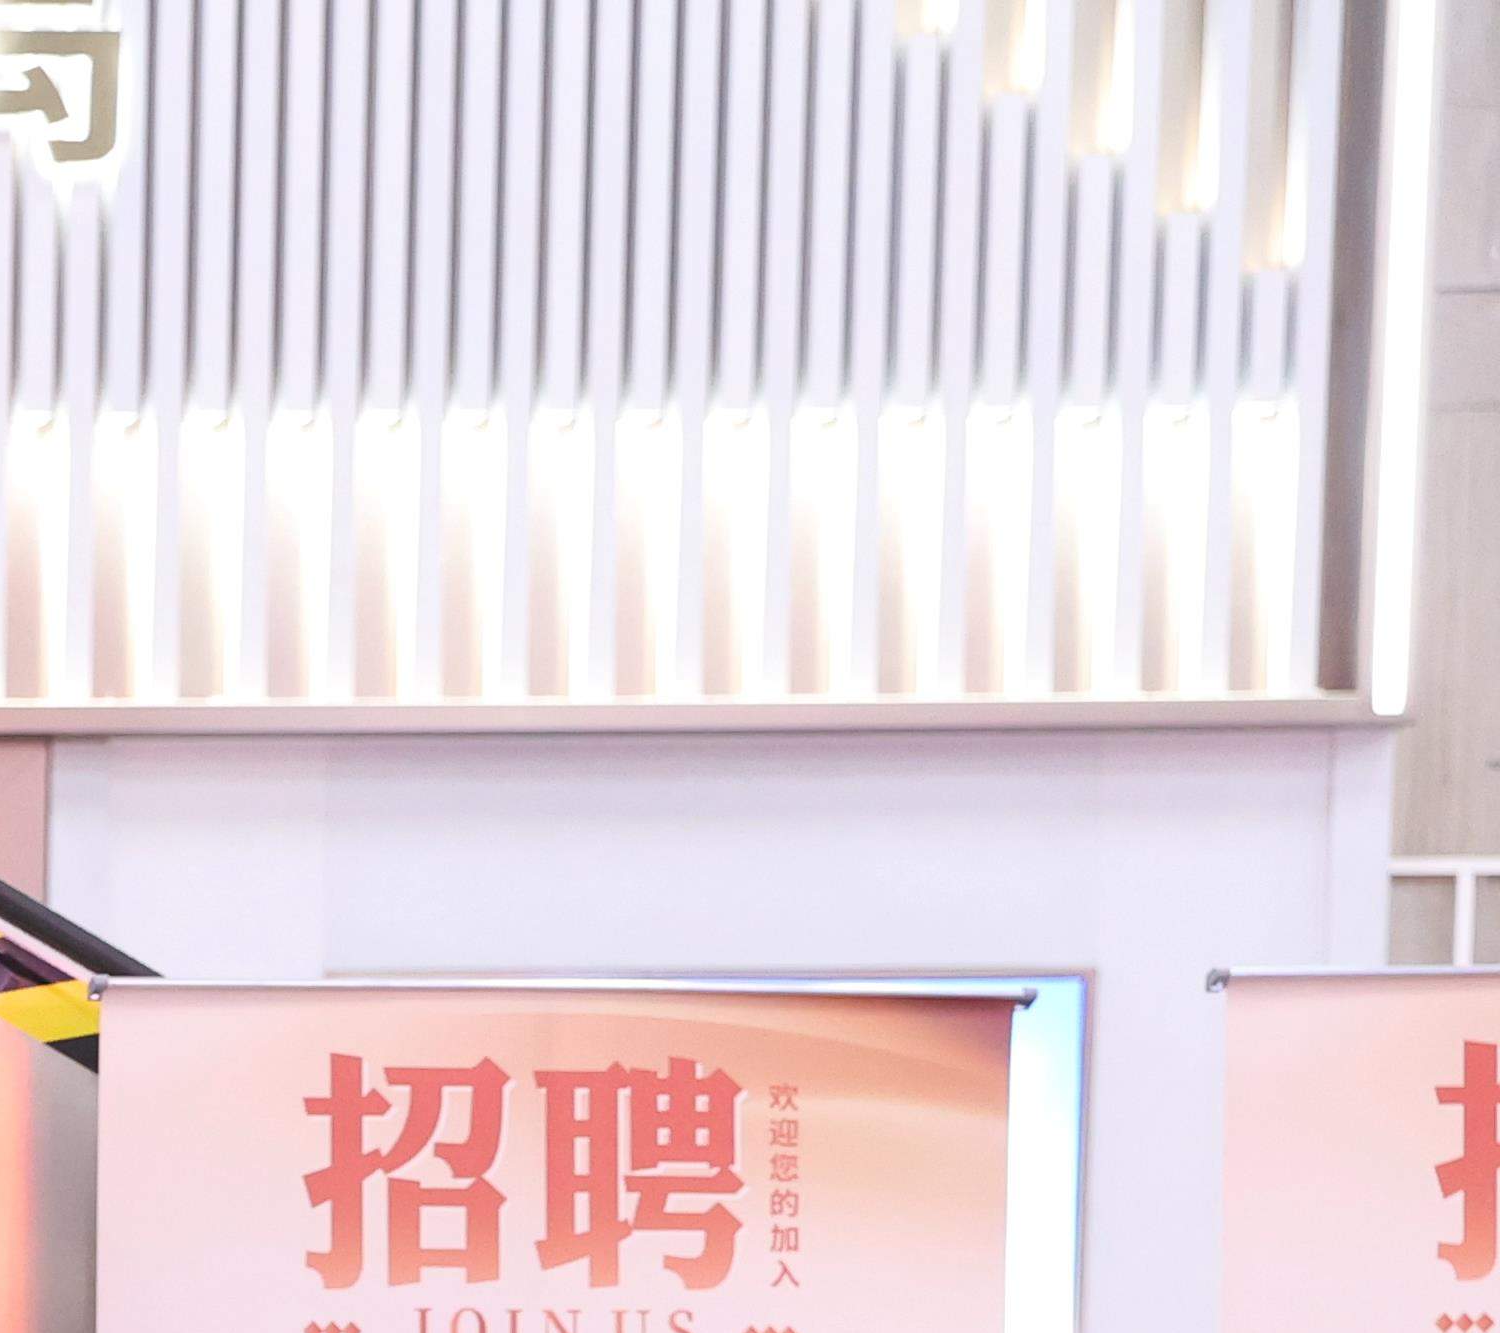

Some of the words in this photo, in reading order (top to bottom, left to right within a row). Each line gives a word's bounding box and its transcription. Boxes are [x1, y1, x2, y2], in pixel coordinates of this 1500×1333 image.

[303, 1052, 743, 1291] 招聘
[768, 1083, 800, 1288] 欢迎您的加入
